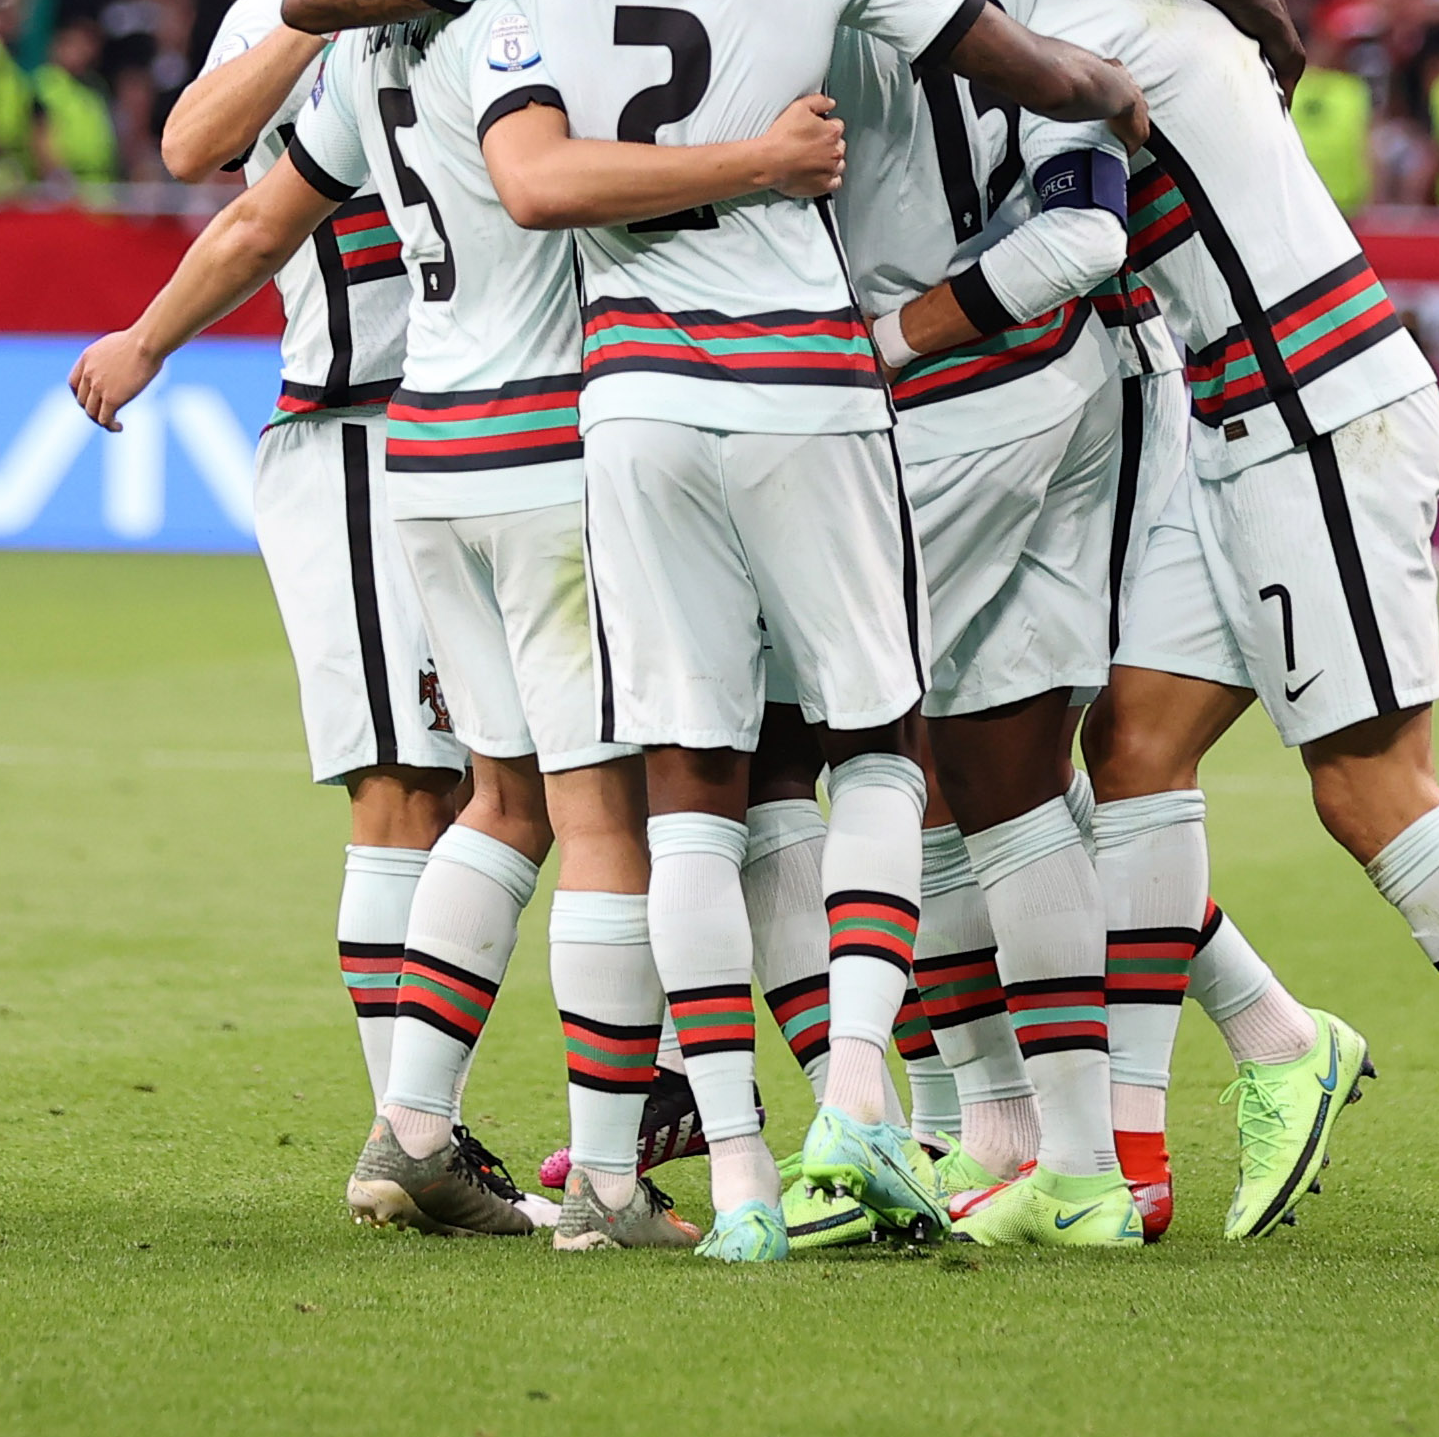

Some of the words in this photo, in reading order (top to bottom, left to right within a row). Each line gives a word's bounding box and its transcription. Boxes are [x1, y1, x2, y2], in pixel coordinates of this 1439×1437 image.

[378, 87, 456, 302] 5
[614, 4, 719, 233] 2
[1259, 583, 1296, 672] 7
